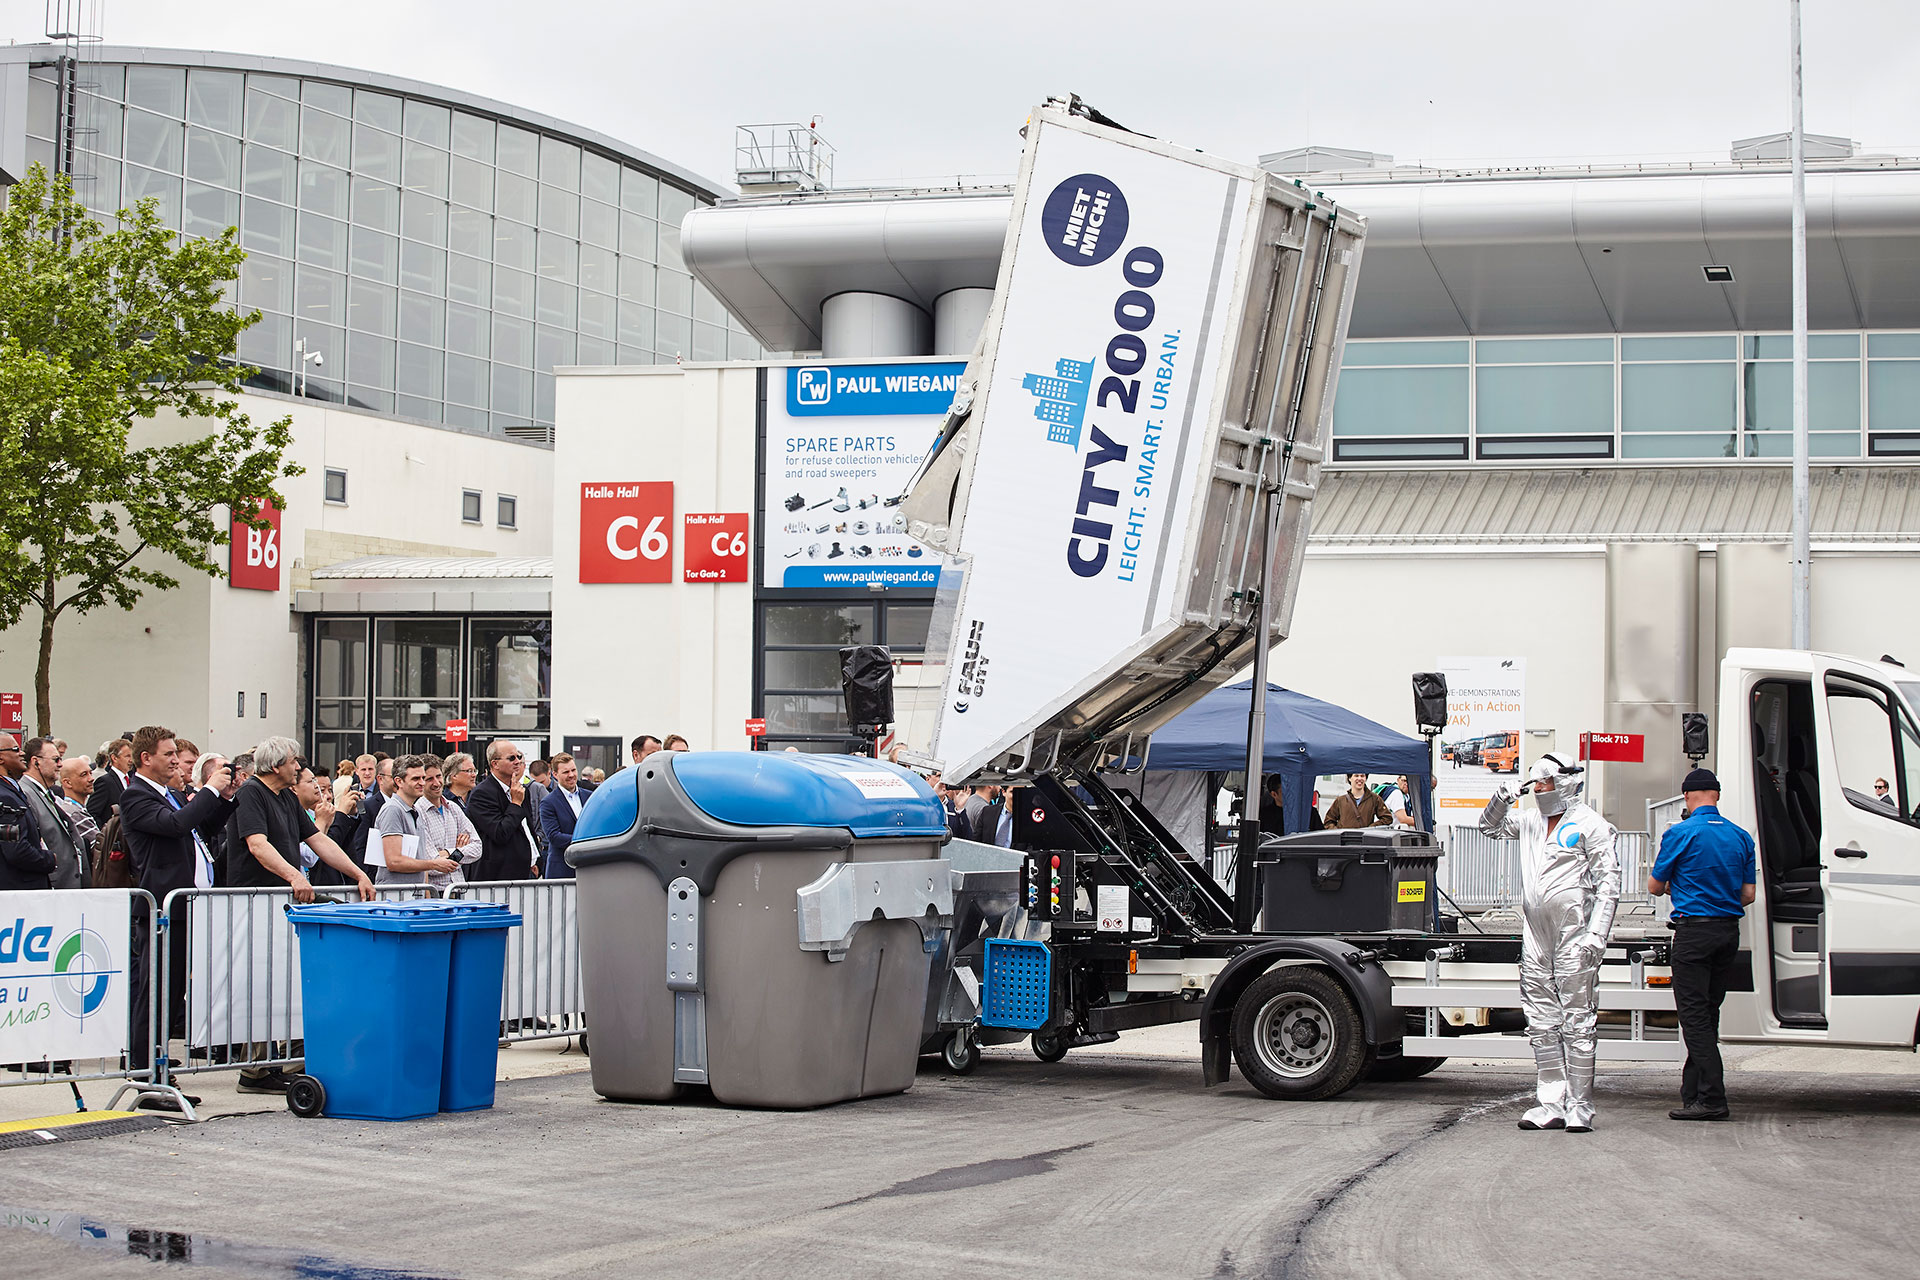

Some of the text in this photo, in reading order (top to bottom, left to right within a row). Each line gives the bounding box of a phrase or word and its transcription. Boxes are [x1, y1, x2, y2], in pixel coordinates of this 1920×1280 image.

[1062, 188, 1091, 247] MIET
[1079, 190, 1111, 256] MICH!
[837, 377, 881, 393] PAUL
[1067, 246, 1164, 577] CITY 2000
[786, 437, 895, 452] SPARE PARTS
[785, 454, 925, 465] for refuse collection vehicles
[1118, 330, 1181, 582] LEICHT. SMART. URBAN.
[785, 468, 877, 480] and road sweepers
[584, 486, 639, 498] Halle Hall
[686, 515, 725, 524] Halle Hall
[606, 516, 669, 560] C6
[711, 532, 746, 557] C6
[247, 525, 278, 569] B6
[686, 569, 726, 578] Tor Gate 2
[823, 570, 935, 584] www.paulwiegand.de
[1473, 701, 1483, 711] in
[1486, 701, 1520, 711] Action
[12, 711, 22, 722] B6
[1592, 734, 1613, 743] Block
[1614, 735, 1629, 744] 713
